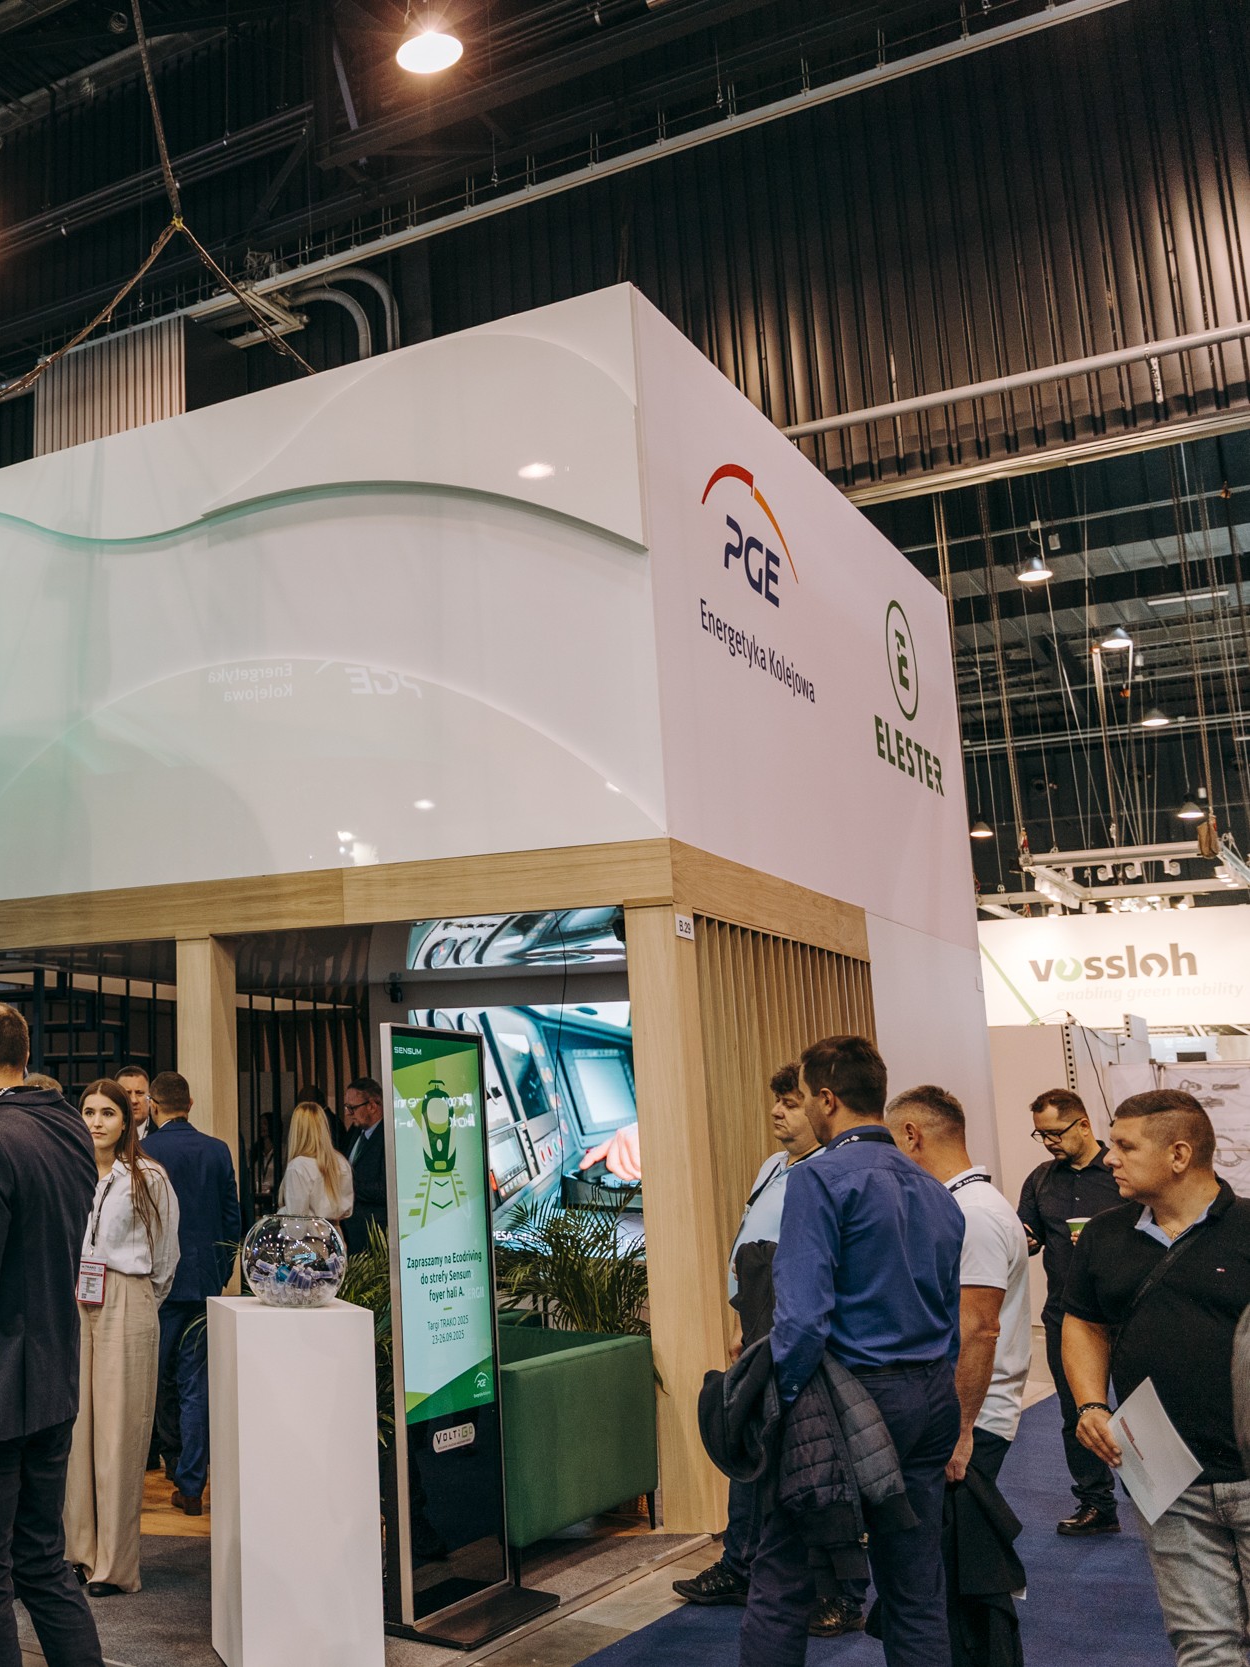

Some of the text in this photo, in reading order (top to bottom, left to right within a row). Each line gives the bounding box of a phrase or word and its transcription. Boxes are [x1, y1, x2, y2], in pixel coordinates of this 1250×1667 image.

[723, 514, 780, 609] PGE
[699, 597, 816, 704] Energetyka Kolejowa
[874, 714, 945, 798] ELESTER
[679, 920, 692, 935] B.29
[1028, 942, 1199, 982] vossloh
[1056, 981, 1244, 1002] enabling green mobility
[393, 1046, 423, 1056] SENSUM
[406, 1249, 482, 1271] Zapraszamy na Ecodriving
[420, 1269, 472, 1285] do strefy Sensum
[428, 1286, 465, 1303] foyer hali A.
[427, 1314, 469, 1332] Targi TRAKO 2025
[431, 1329, 465, 1345] 23-26.09.2025
